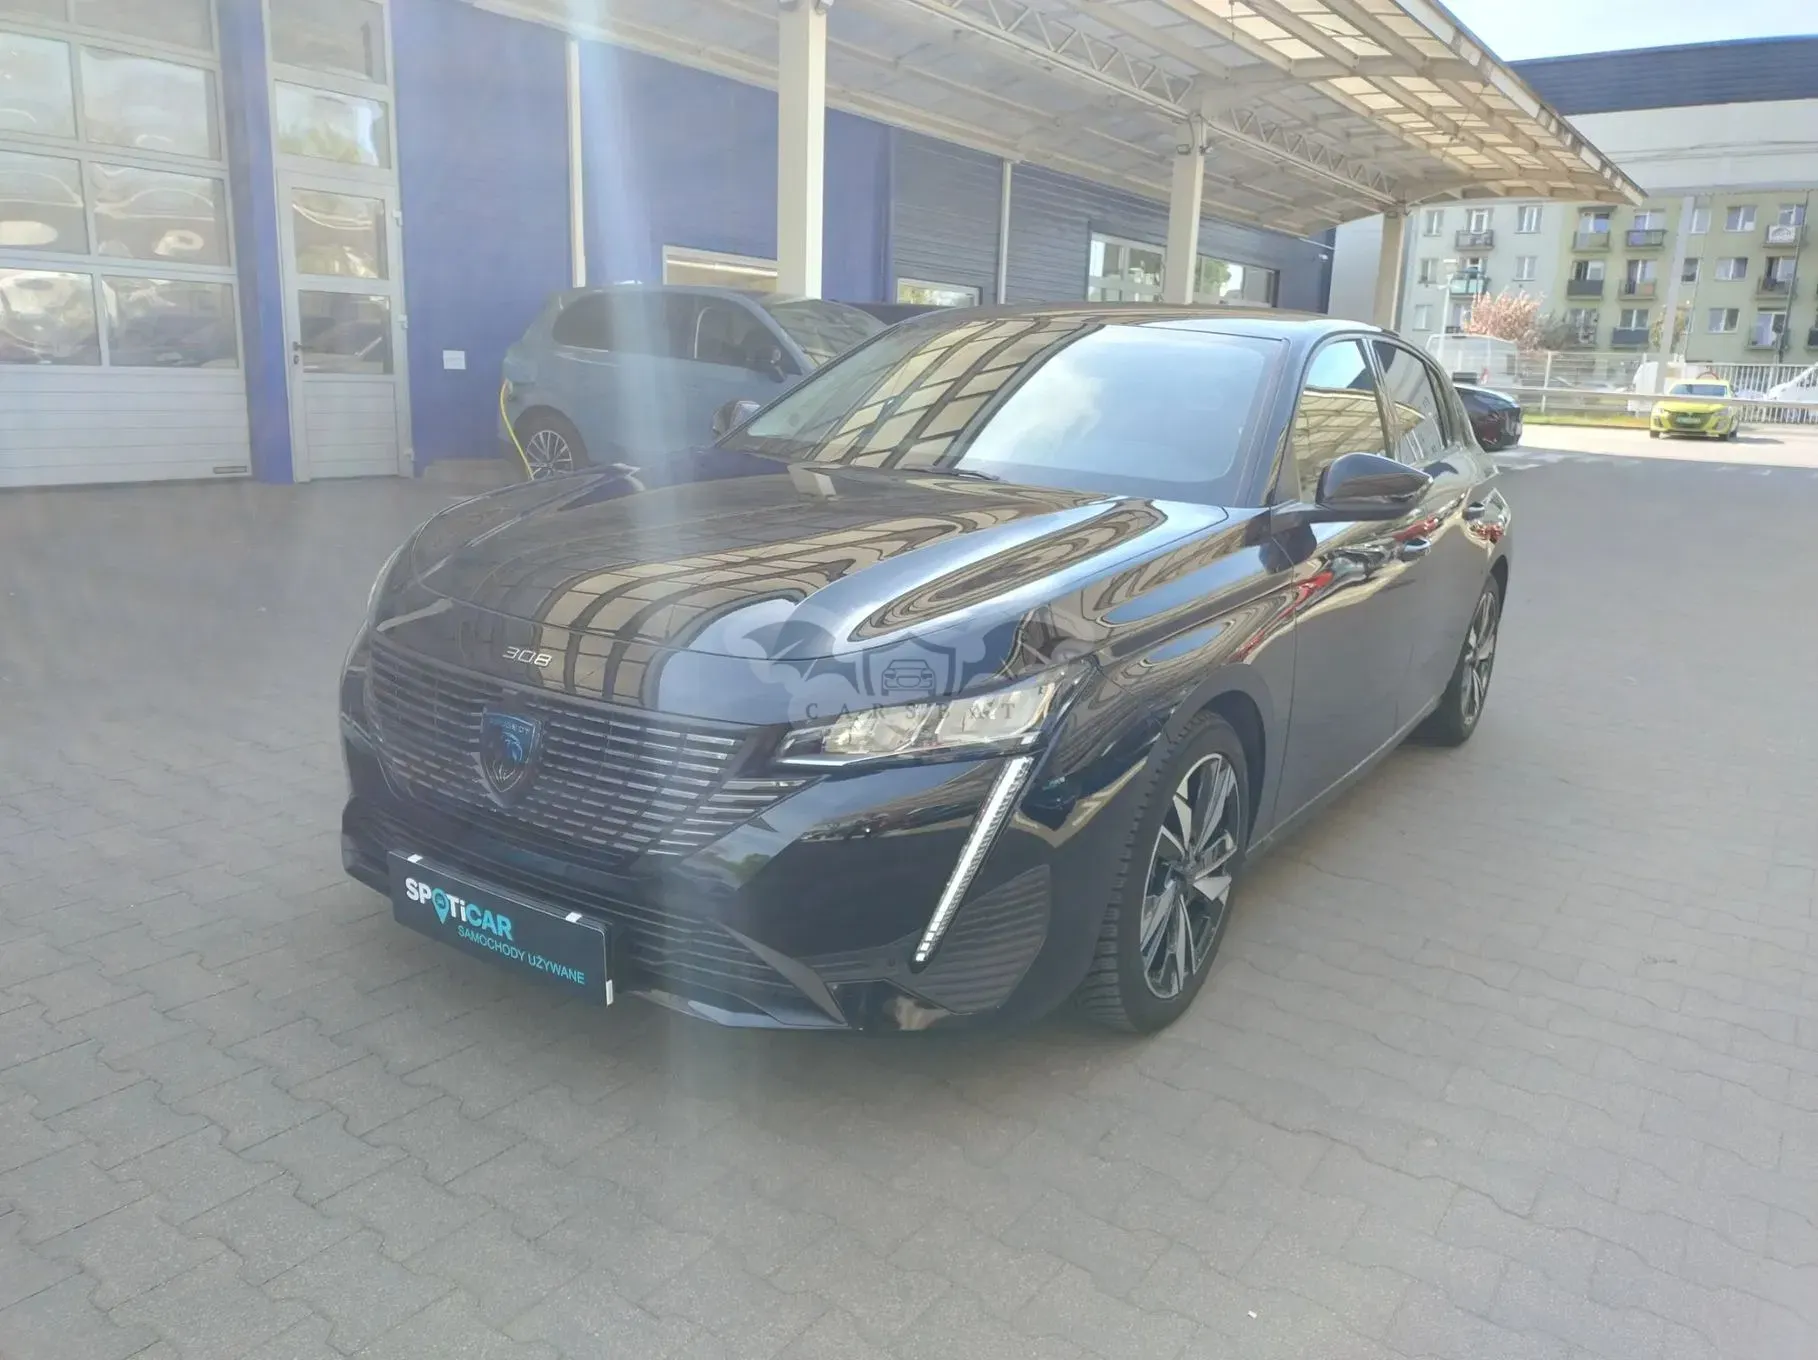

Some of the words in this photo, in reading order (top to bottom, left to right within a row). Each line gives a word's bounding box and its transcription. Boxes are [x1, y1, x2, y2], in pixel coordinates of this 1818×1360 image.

[502, 646, 552, 667] 308
[457, 924, 526, 961] SAMOCHODY
[527, 953, 585, 984] UŻYWANE
